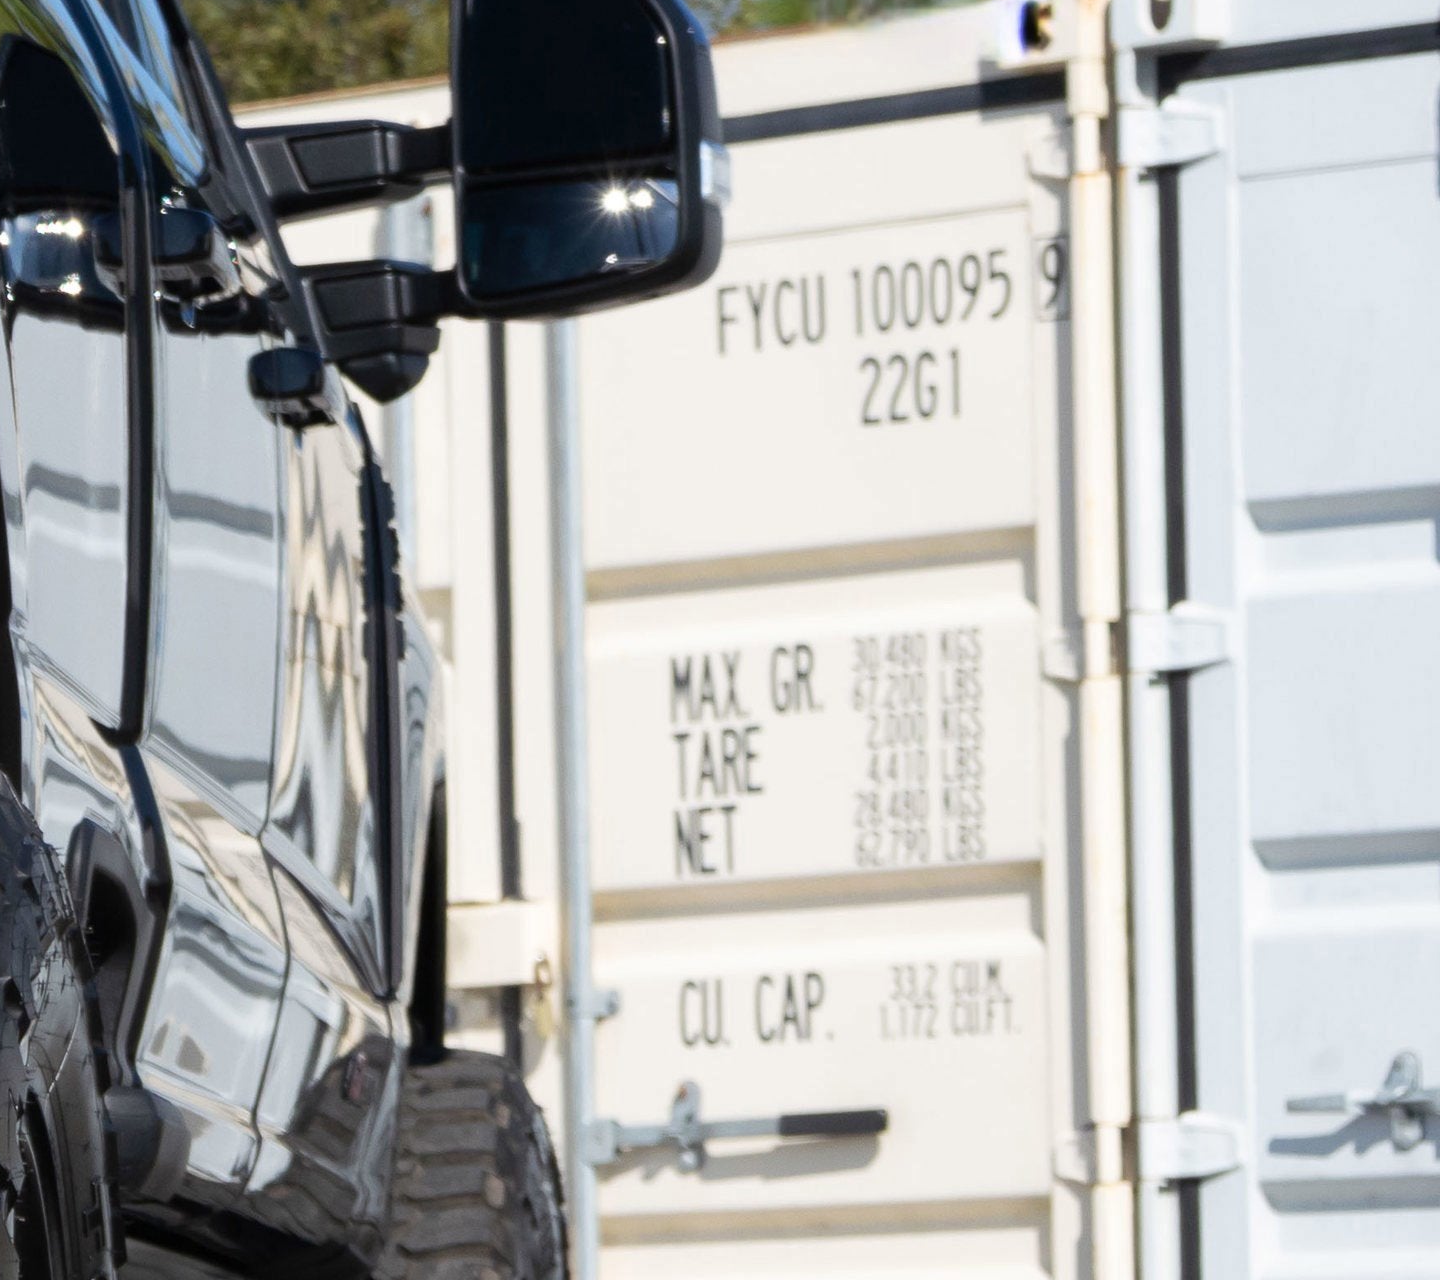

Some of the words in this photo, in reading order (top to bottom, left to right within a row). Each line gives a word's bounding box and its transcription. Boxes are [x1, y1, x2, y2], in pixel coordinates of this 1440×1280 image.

[717, 274, 827, 356] FYCU
[851, 248, 1013, 337] 100095
[1040, 242, 1065, 310] 9
[860, 347, 961, 426] 22G1
[770, 643, 825, 714] GR.
[940, 628, 983, 662] KGS
[940, 667, 983, 704] LBS
[671, 724, 764, 802] TARE
[941, 707, 984, 741] KGS
[941, 745, 984, 782] LBS
[673, 804, 737, 878] NET
[942, 785, 985, 820] KGS
[943, 824, 986, 861] LBS
[679, 977, 730, 1047] CU.
[754, 970, 834, 1041] CAP.
